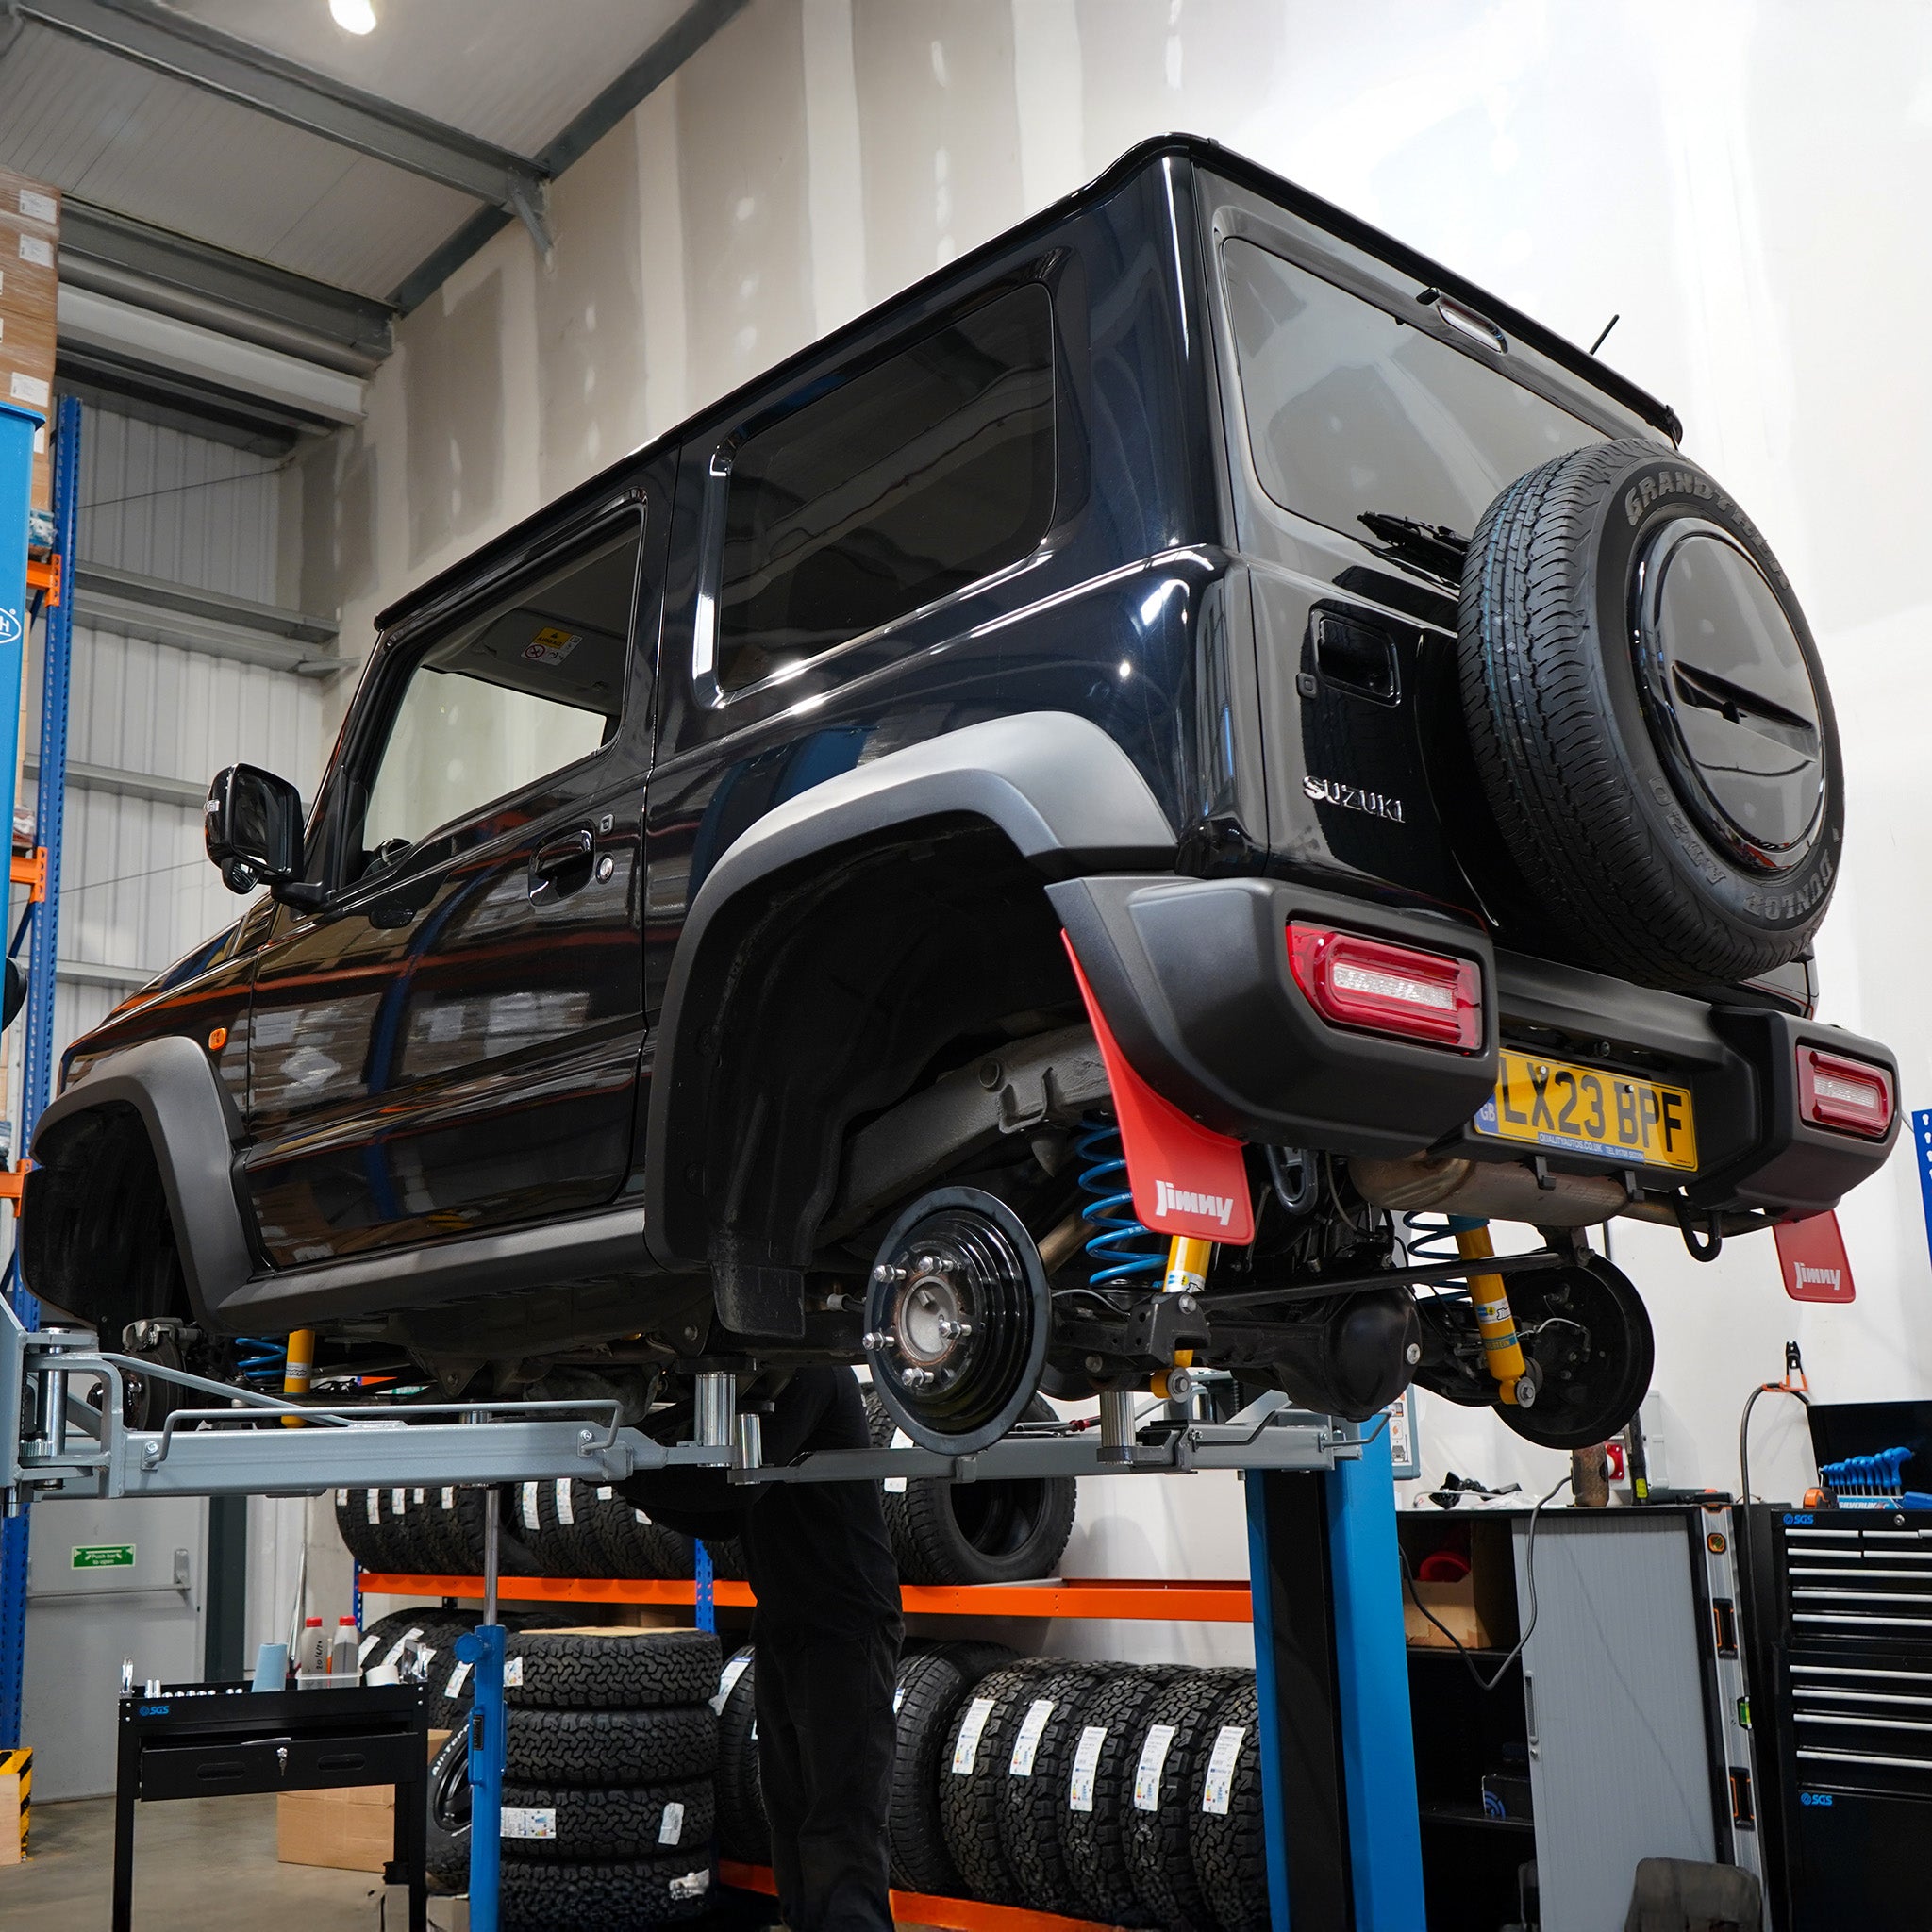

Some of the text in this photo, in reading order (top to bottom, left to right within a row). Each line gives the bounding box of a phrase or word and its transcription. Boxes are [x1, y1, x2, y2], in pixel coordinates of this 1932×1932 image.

[1303, 775, 1406, 824] SUZUKI
[1743, 849, 1835, 921] DUNLOP
[1480, 1102, 1496, 1122] GB
[1500, 1056, 1682, 1153] LX23 BPF
[1793, 1514, 1814, 1525] SGS
[150, 1705, 170, 1716] SGS
[432, 1723, 471, 1776] All-Terr
[1811, 1793, 1833, 1807] SGS
